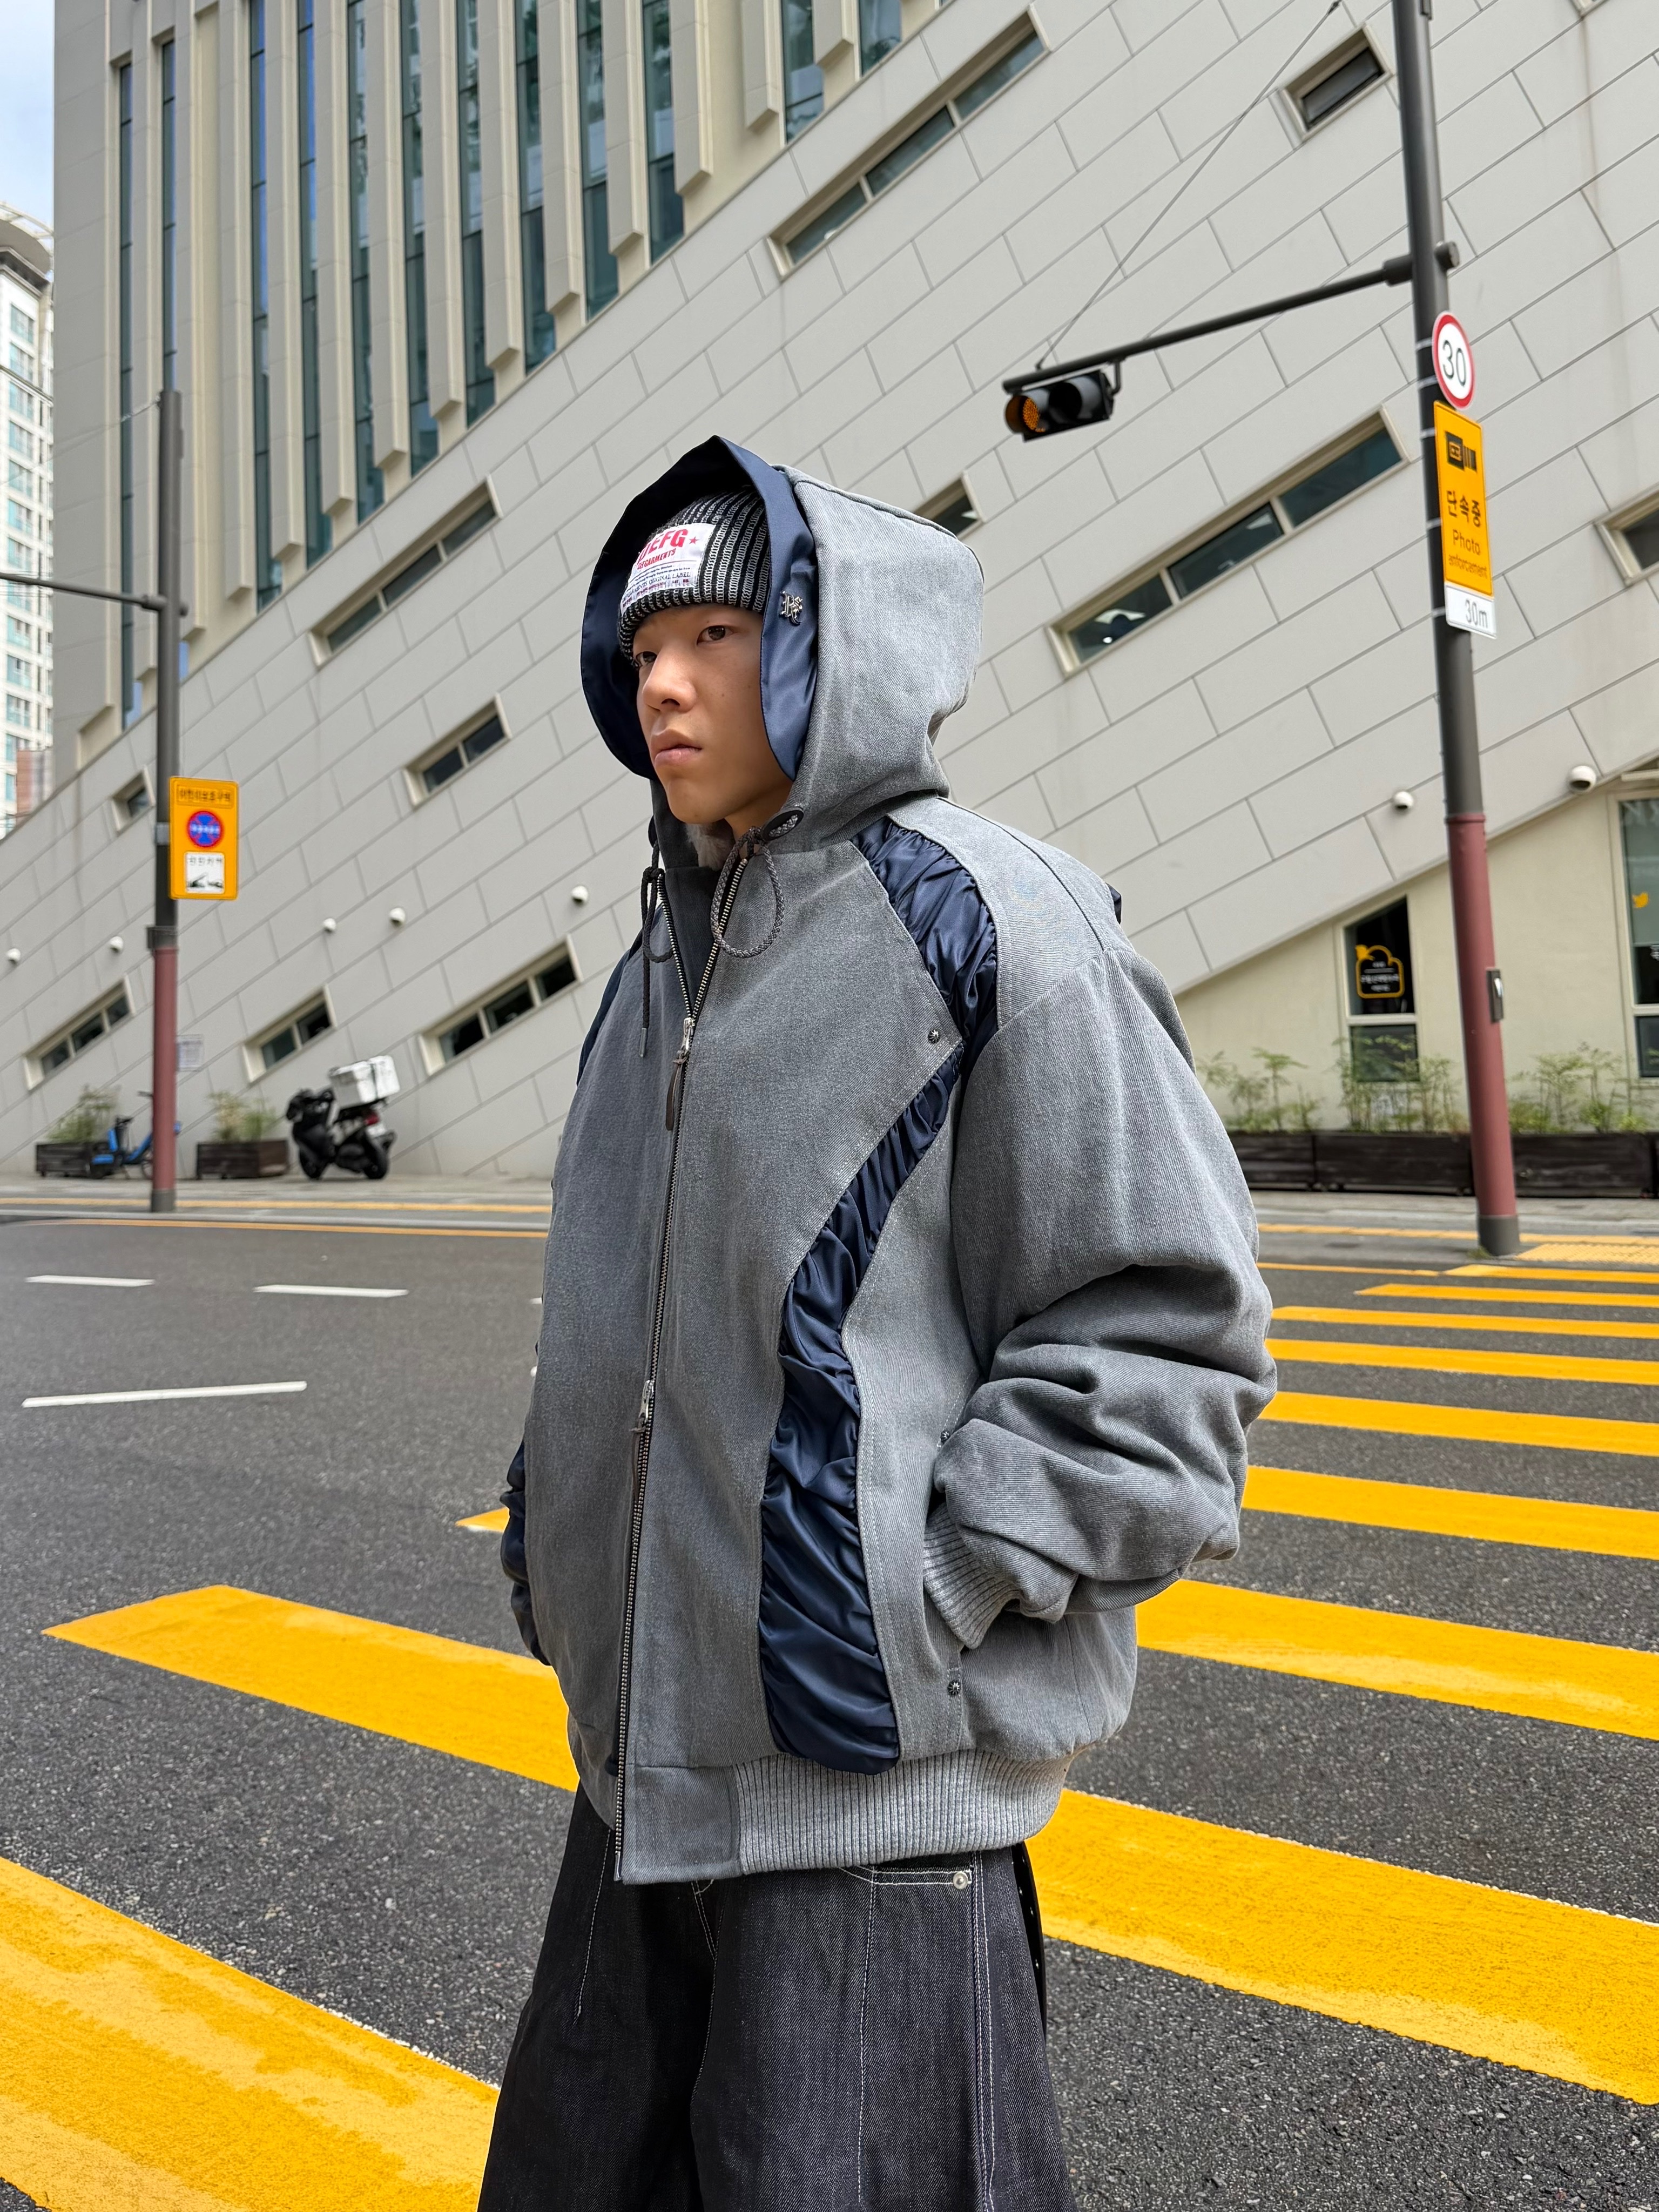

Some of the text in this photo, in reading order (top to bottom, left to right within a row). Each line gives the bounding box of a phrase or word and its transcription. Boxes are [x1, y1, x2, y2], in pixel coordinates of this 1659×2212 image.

[1442, 340, 1467, 387] 30
[1447, 490, 1481, 528] 단속중
[1453, 529, 1481, 556] Photo
[1465, 599, 1488, 628] 30m
